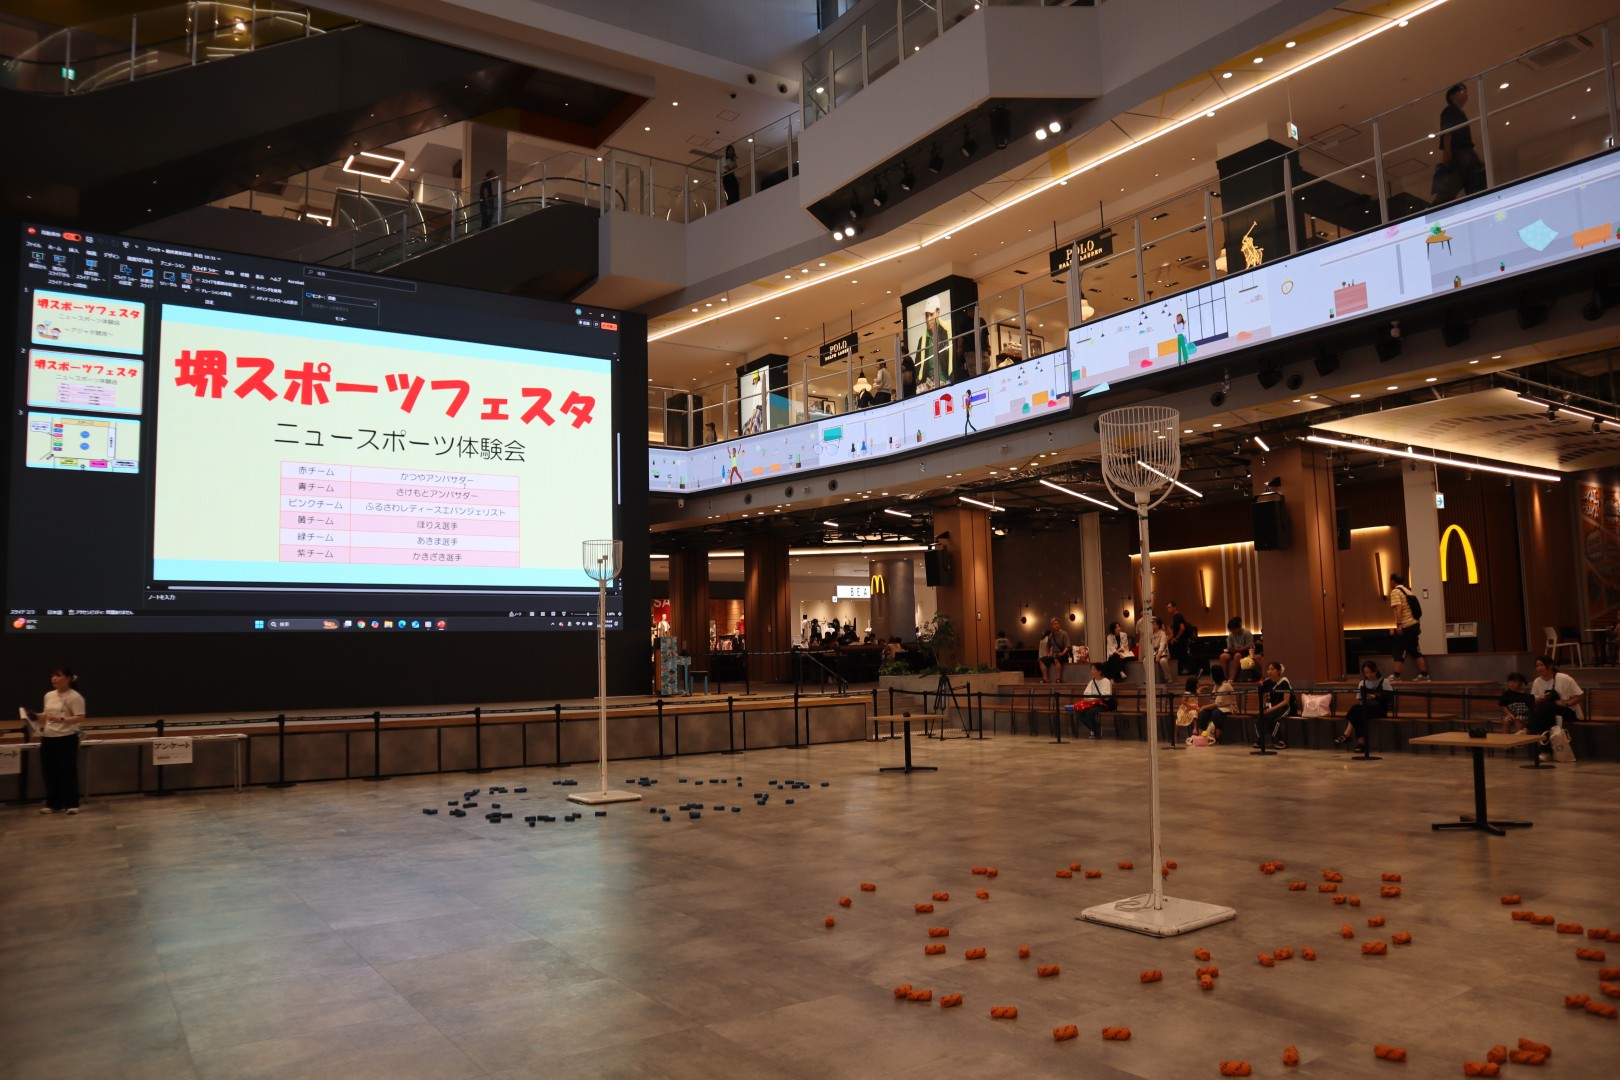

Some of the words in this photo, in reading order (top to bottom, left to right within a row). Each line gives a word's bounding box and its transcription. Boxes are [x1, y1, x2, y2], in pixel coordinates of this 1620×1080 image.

[1066, 240, 1095, 260] PLO
[37, 298, 140, 319] 堺スポーツフェスタ
[829, 340, 848, 354] POLO
[34, 359, 138, 378] 堺スポーツフェスタ
[174, 349, 597, 429] 堺スポーツフェスタ
[274, 422, 527, 463] ニュースポーツ体験会
[298, 466, 335, 476] 赤チーム
[400, 472, 475, 484] かつやアンバサダー
[298, 482, 335, 493] 青チーム
[297, 515, 334, 525] 黄チーム
[416, 520, 459, 531] ほりえ選手
[297, 532, 334, 542] 緑チーム
[296, 548, 334, 559] 紫チーム
[154, 741, 191, 750] アンケート
